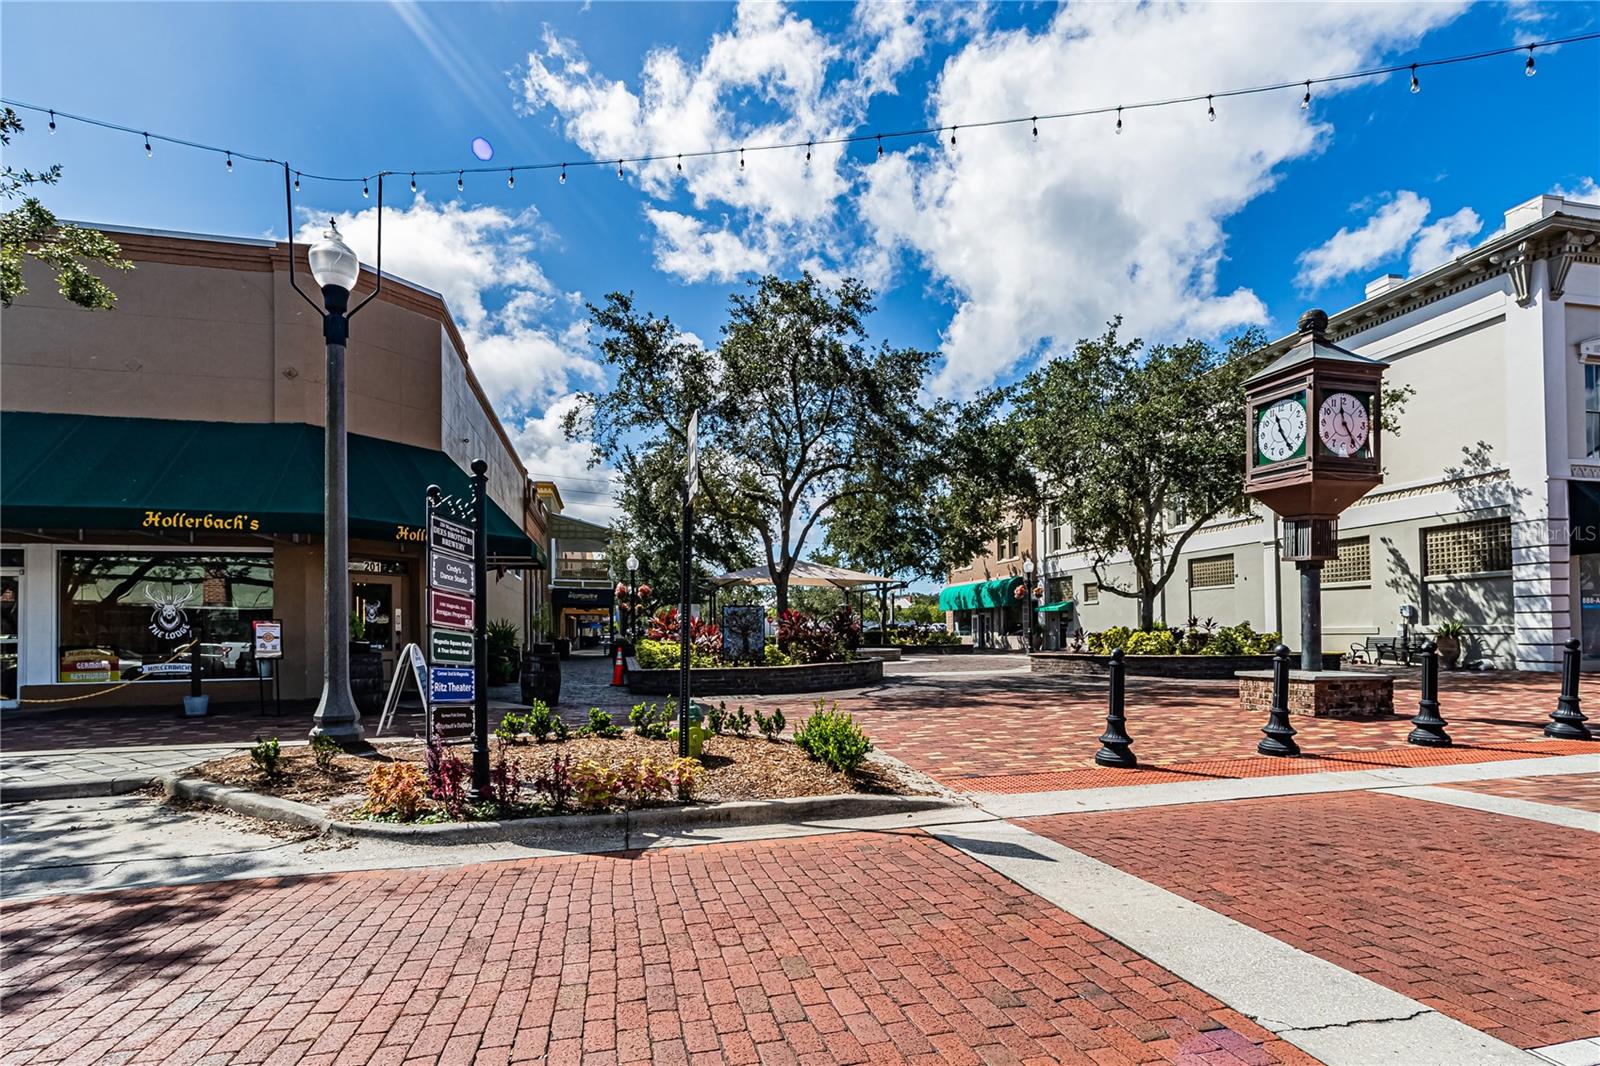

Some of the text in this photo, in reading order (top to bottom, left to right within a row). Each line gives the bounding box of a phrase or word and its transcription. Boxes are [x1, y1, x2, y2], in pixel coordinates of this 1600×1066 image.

[142, 511, 259, 530] Hollerbach's
[433, 526, 473, 545] DEES BROTHERS
[442, 538, 465, 551] BREWERY
[365, 562, 380, 572] 201
[440, 572, 467, 584] Dance Studio
[148, 624, 190, 640] THE LODGE
[434, 682, 471, 692] Ritz Theater
